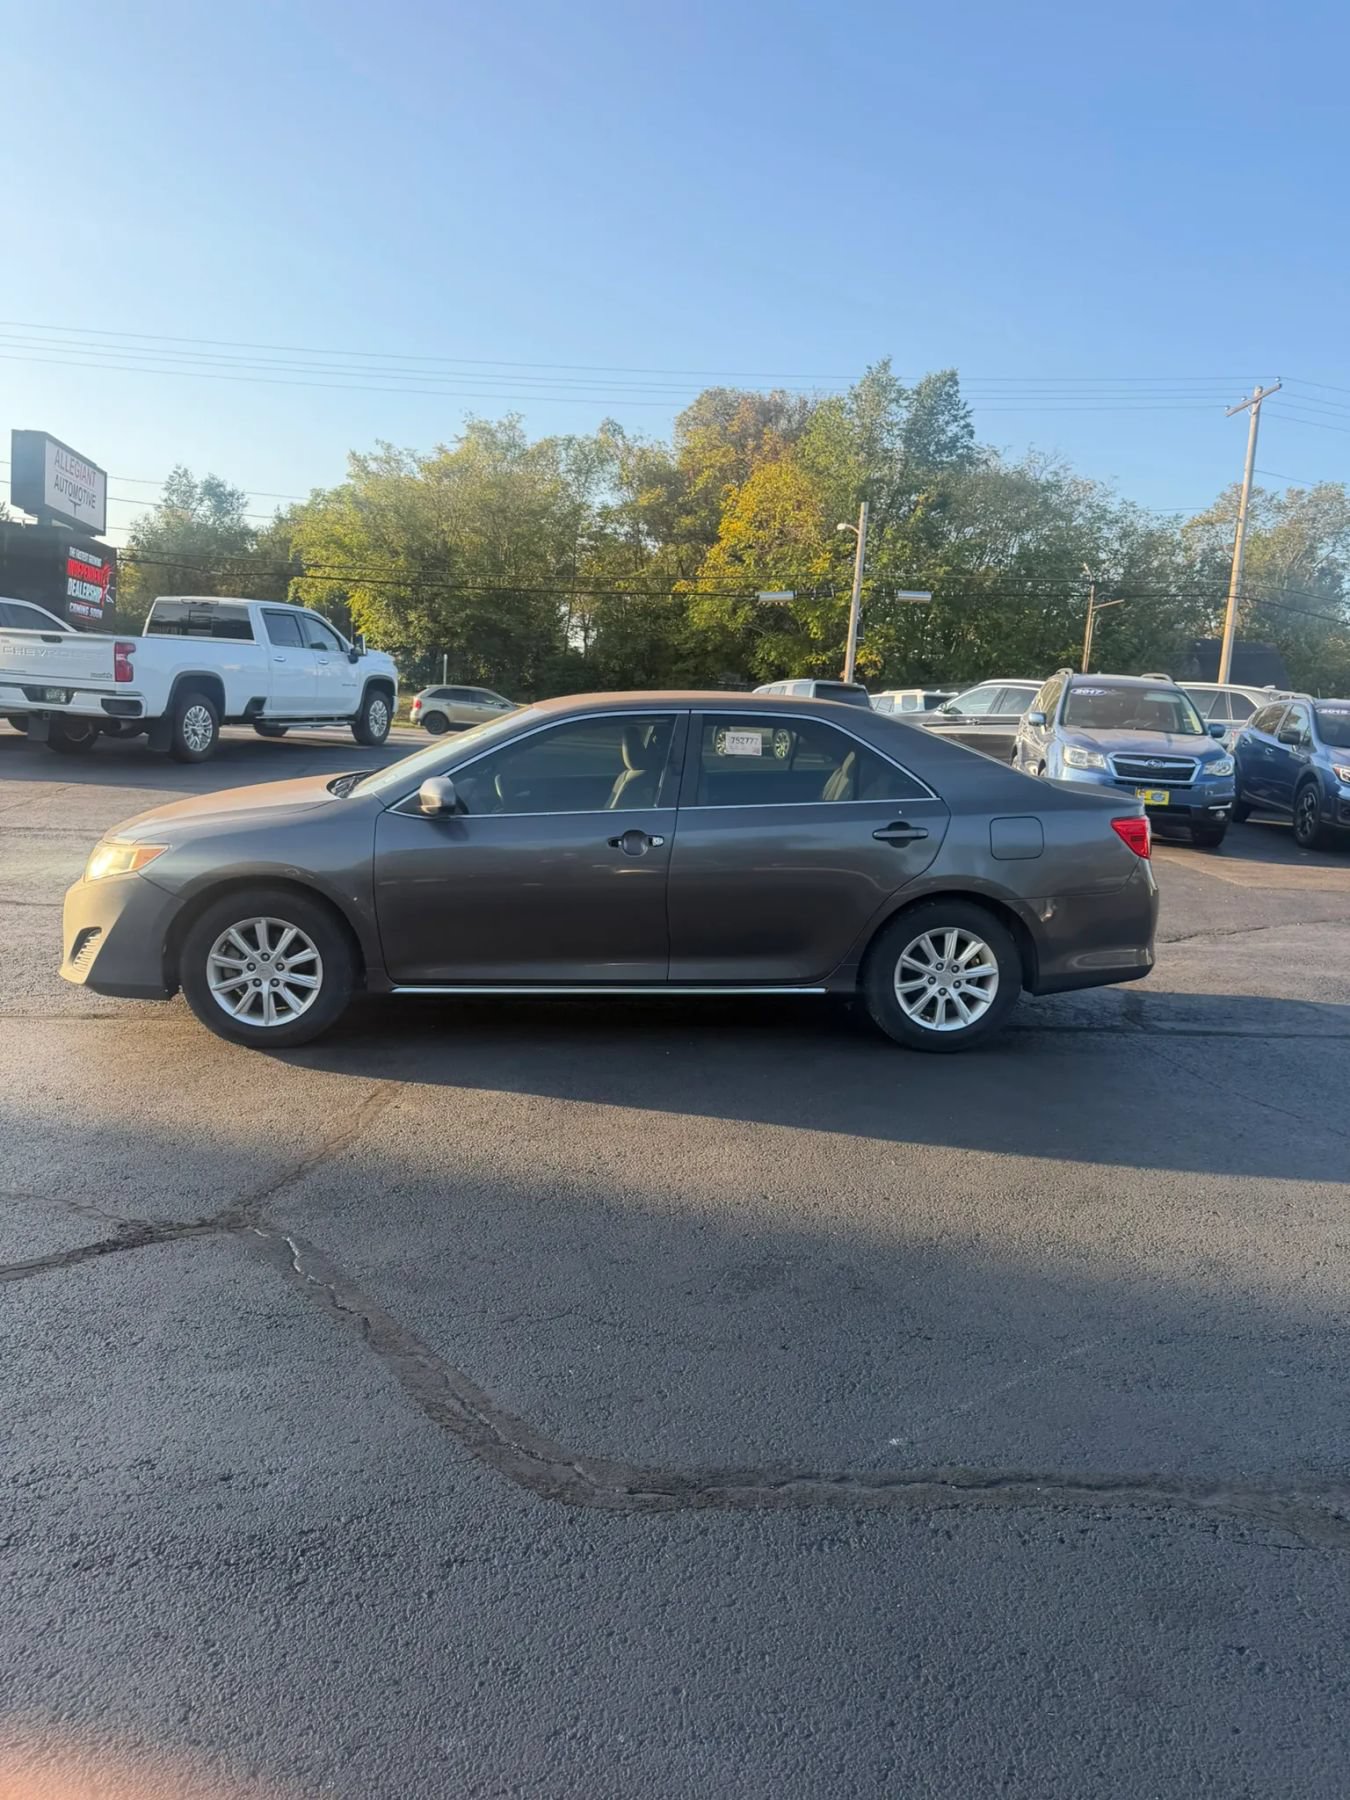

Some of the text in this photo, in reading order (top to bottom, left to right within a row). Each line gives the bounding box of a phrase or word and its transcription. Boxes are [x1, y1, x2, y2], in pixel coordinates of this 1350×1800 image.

[54, 448, 97, 488] ALLEGIANT
[53, 474, 96, 510] AUTOMOTIVE
[67, 577, 102, 604] DEALERSHIP
[69, 602, 89, 616] COMING
